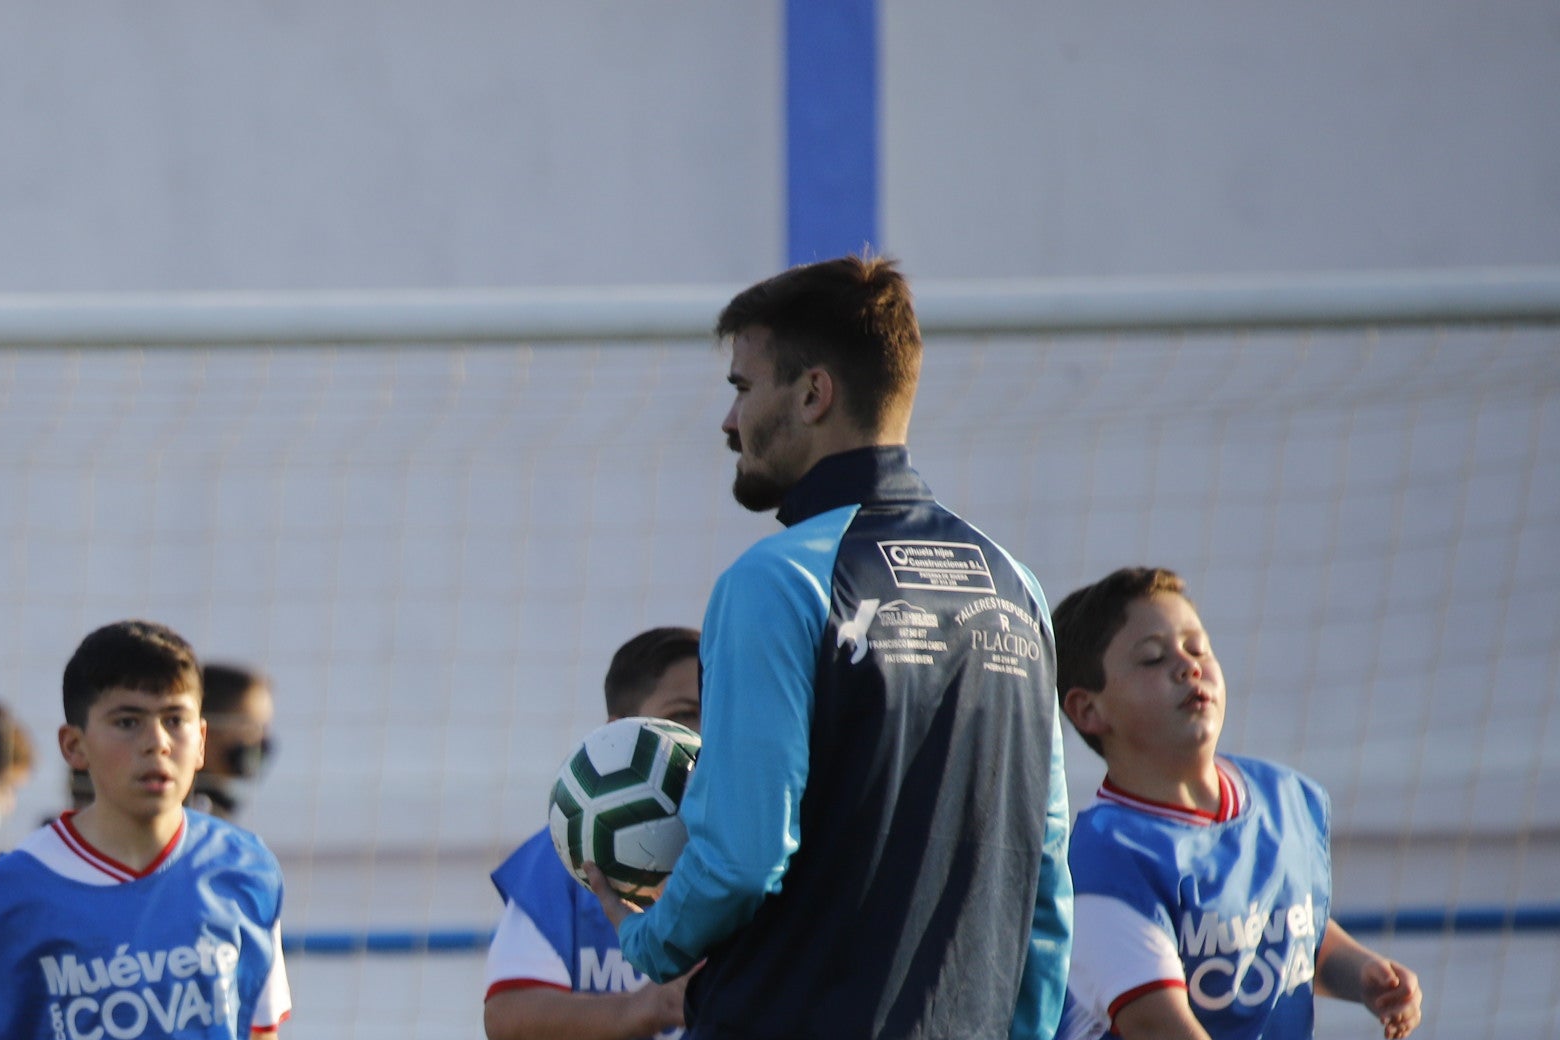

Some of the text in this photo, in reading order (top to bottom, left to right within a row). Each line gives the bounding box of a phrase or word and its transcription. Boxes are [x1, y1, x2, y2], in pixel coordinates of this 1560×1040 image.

[954, 596, 997, 627] TALLERES
[971, 629, 1040, 661] PLACIDO
[40, 935, 238, 996] Muévete
